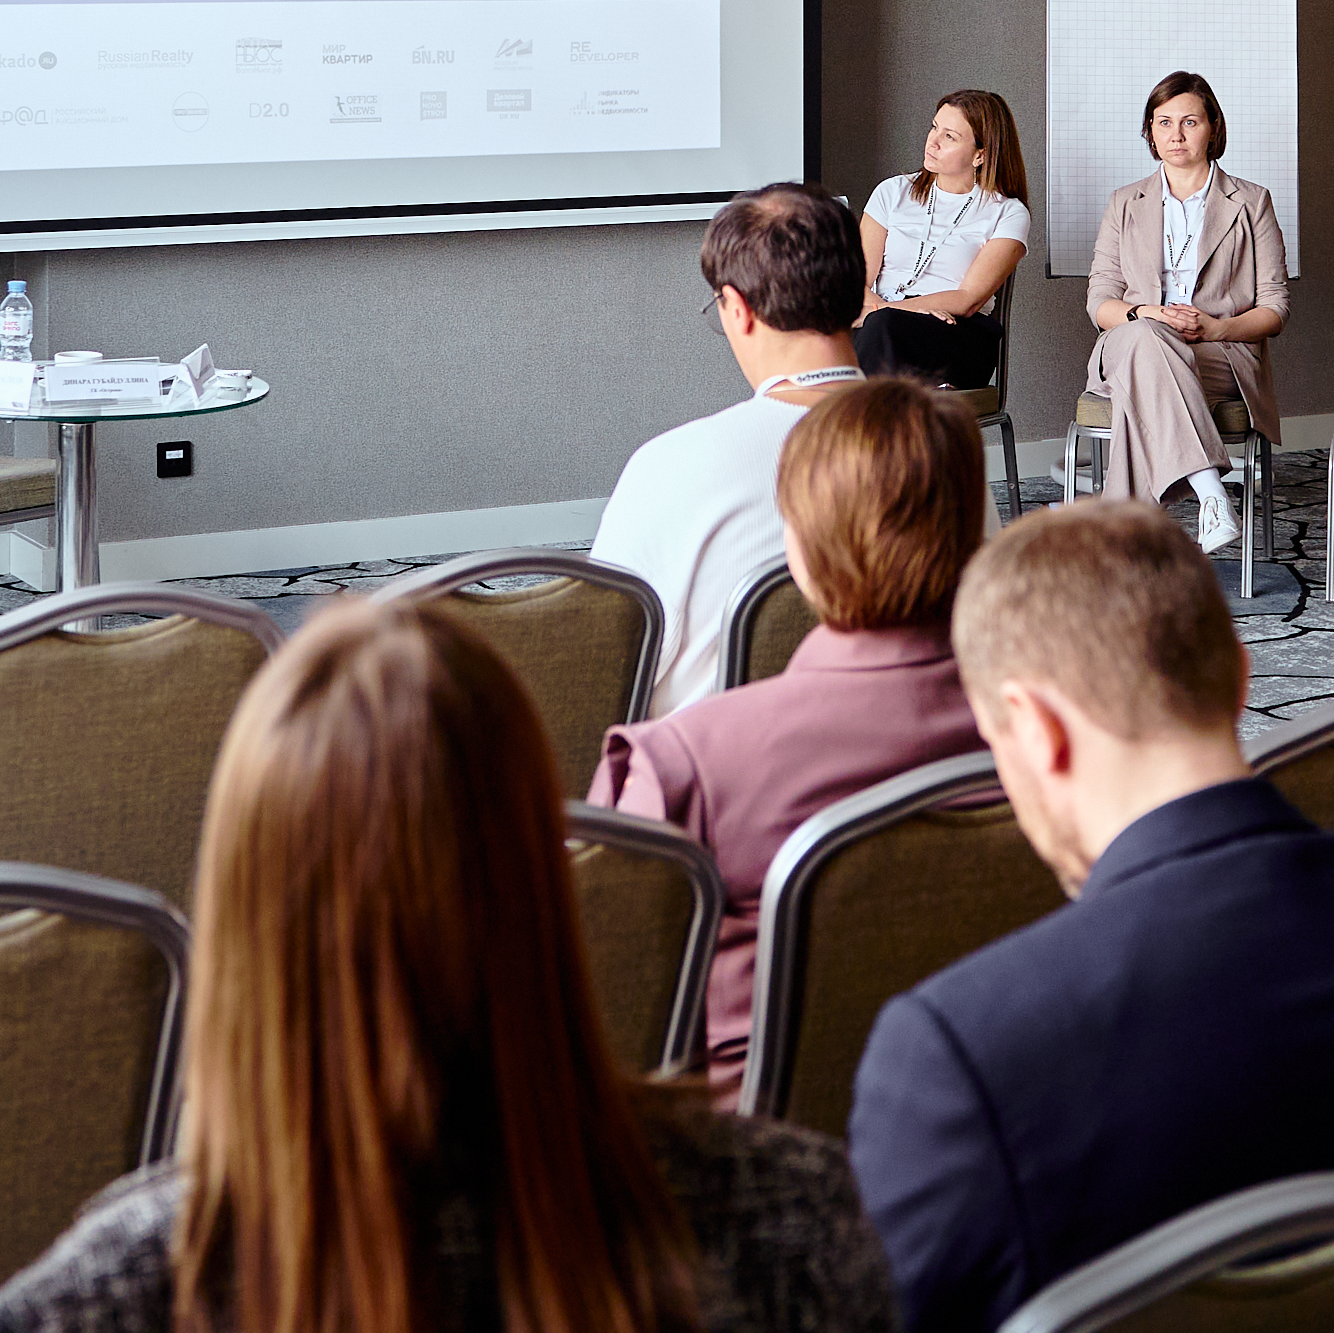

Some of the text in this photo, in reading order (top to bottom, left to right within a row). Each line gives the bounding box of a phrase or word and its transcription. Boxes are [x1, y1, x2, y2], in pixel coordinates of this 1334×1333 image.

[322, 44, 347, 54] МИР
[569, 40, 592, 52] RE
[97, 49, 194, 64] Russian Realty
[321, 54, 374, 65] КВАРТИР
[411, 49, 456, 65] BN.RU
[569, 52, 640, 62] DEVELOPER
[346, 95, 378, 104] OFFICE
[422, 94, 437, 102] PRO
[55, 107, 107, 116] РОССИЙСКИЙ
[249, 102, 290, 118] D2.0
[349, 106, 376, 116] NEWS
[422, 110, 446, 118] STROY
[110, 116, 129, 124] ДОМ
[63, 378, 92, 386] ДИНАРА
